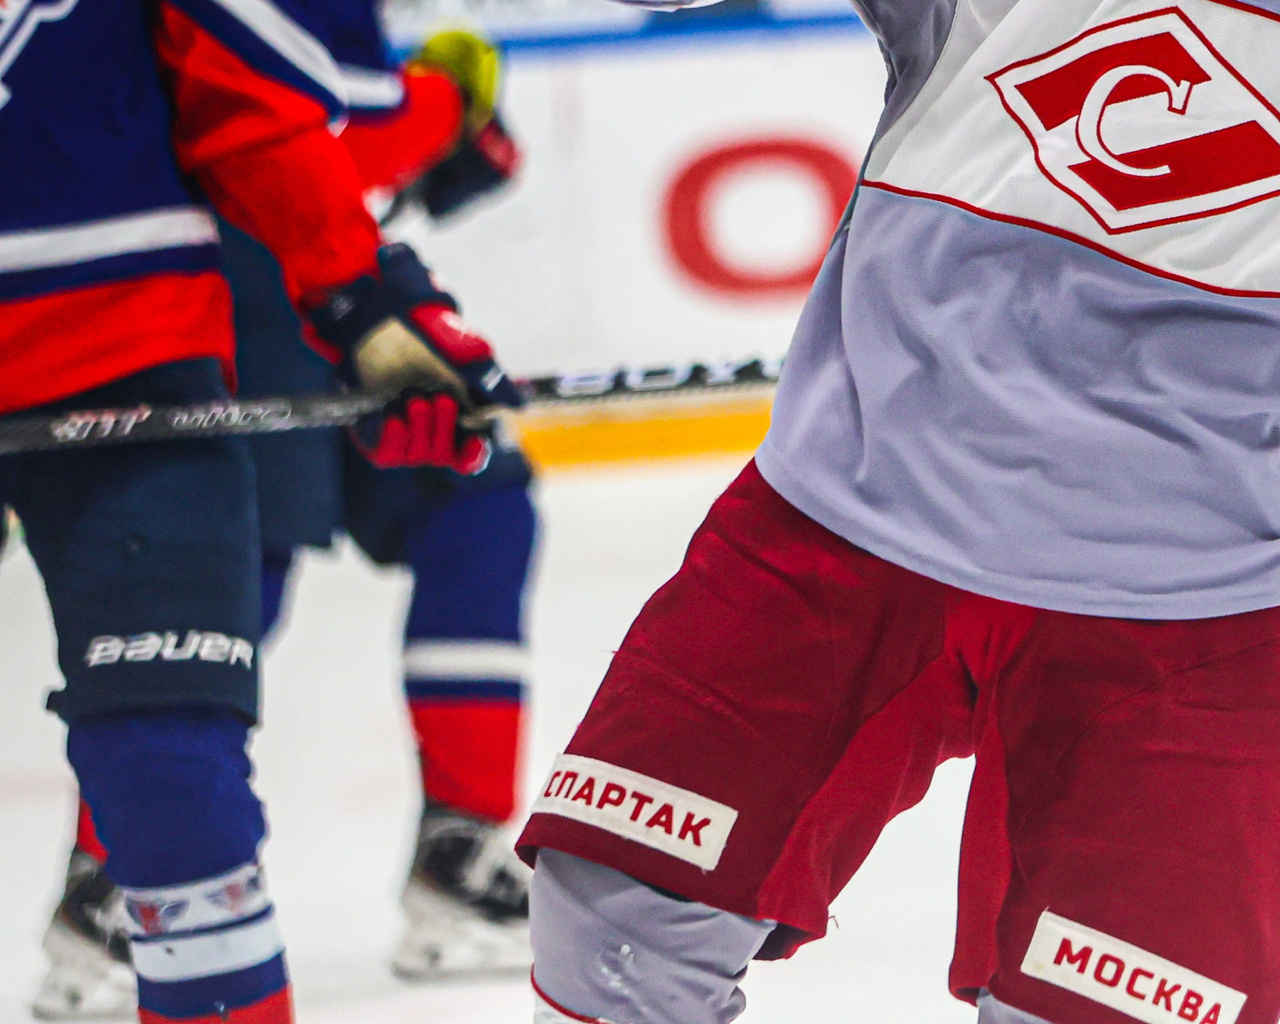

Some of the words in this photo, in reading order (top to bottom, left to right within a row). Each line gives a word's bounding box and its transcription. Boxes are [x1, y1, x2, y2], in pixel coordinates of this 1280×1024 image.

[86, 629, 255, 671] BAUER
[543, 770, 712, 847] СПАРТАК
[1053, 937, 1222, 1024] МОСКВА
